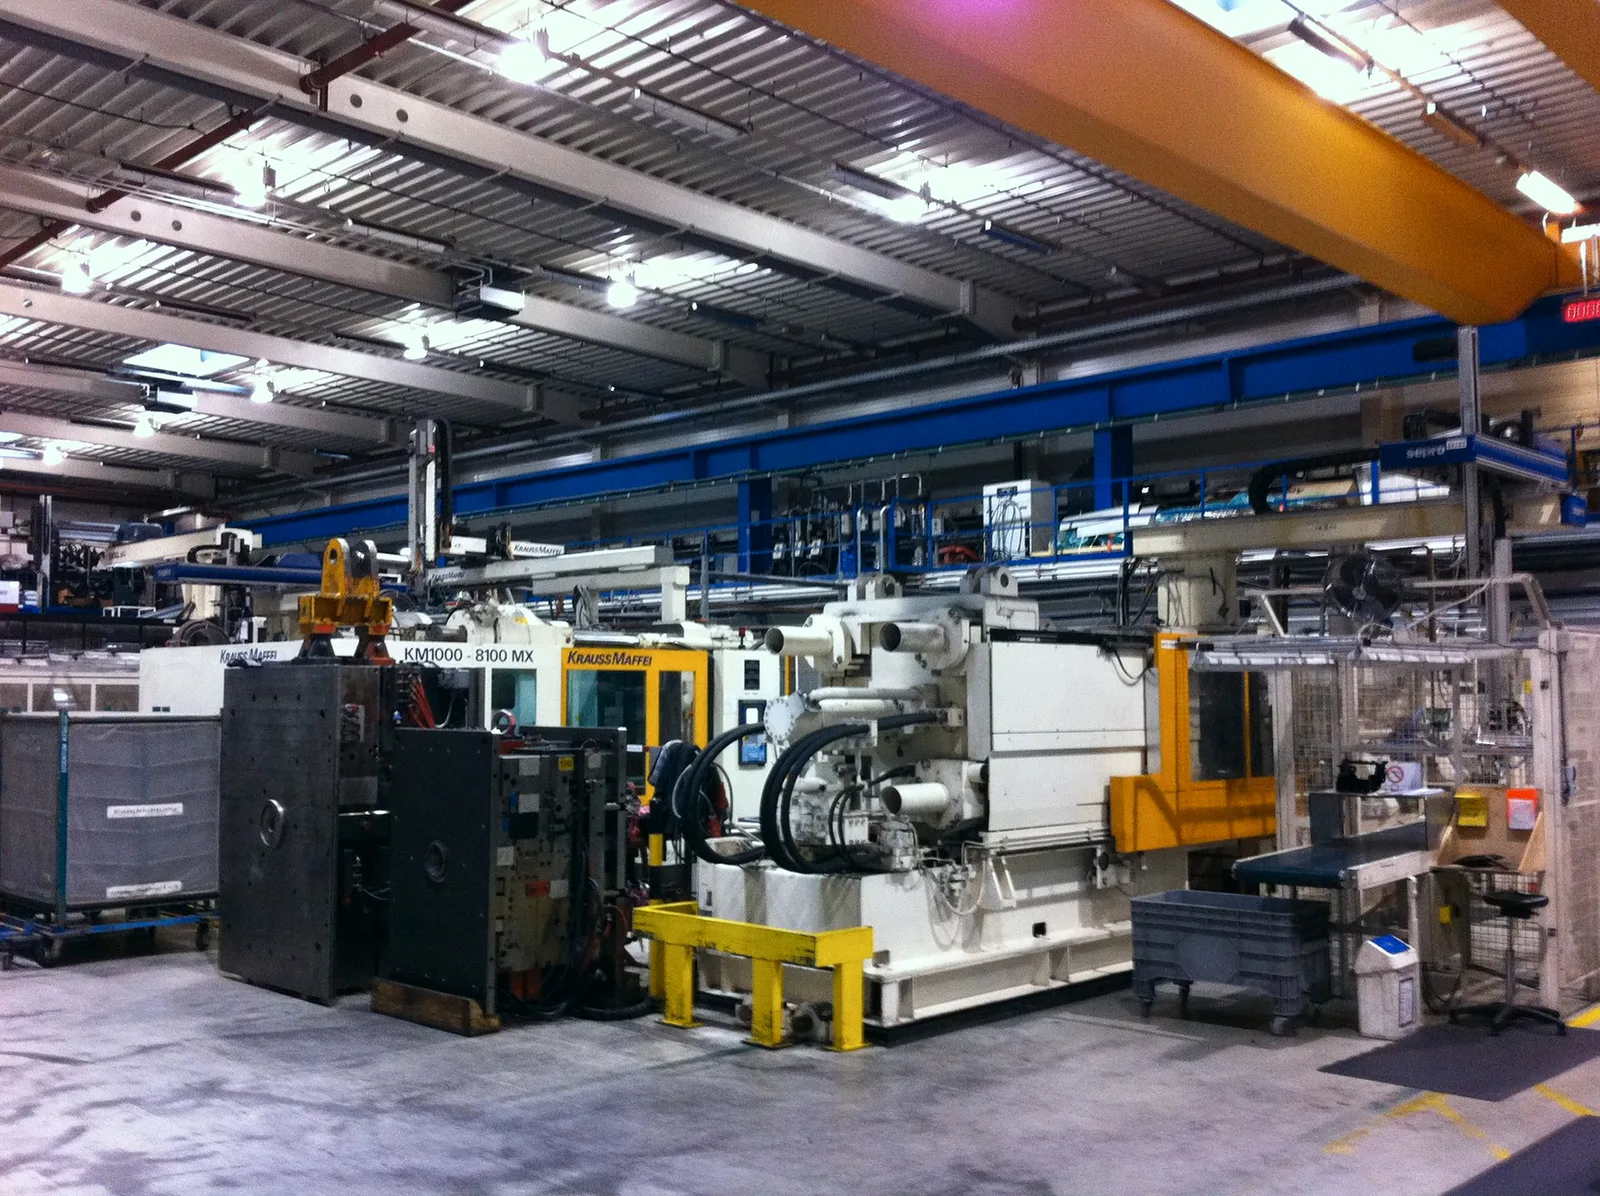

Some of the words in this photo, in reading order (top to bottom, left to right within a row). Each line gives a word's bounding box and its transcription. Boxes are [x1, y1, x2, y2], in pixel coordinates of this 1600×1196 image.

[404, 647, 462, 661] KM1000
[475, 648, 507, 662] 8100
[511, 650, 534, 663] MX
